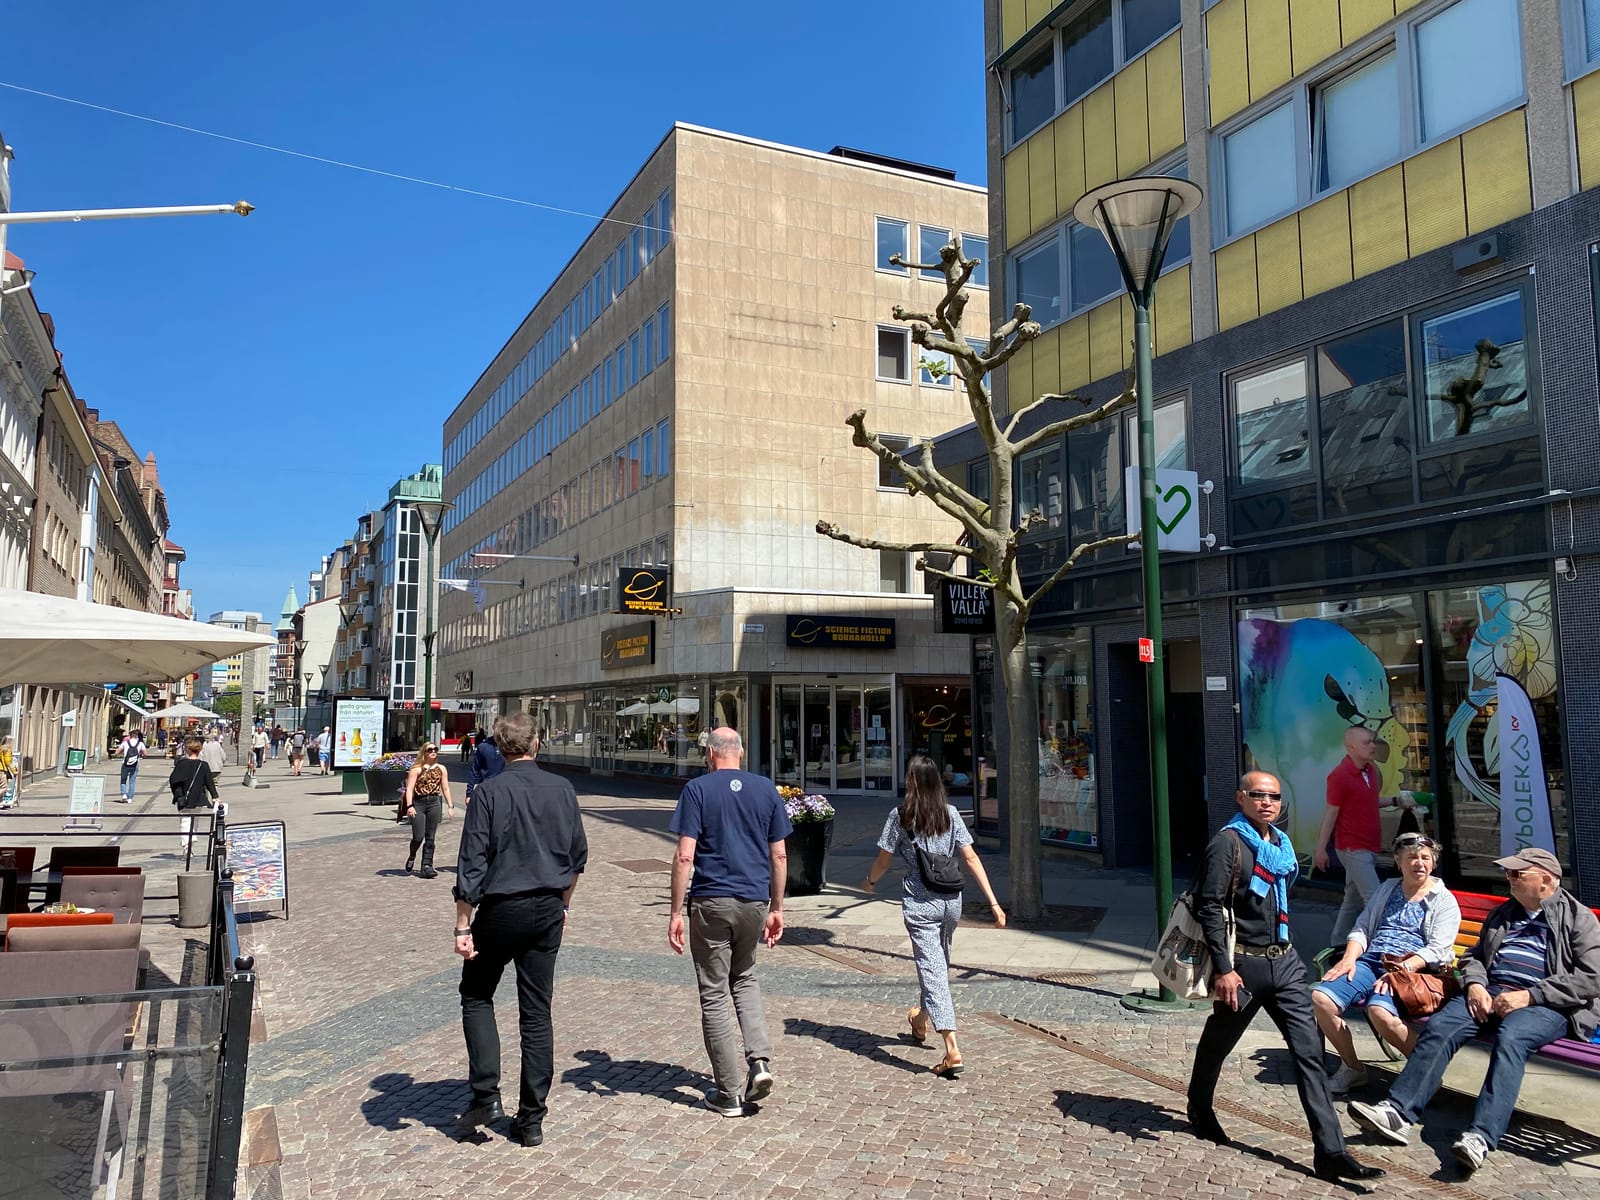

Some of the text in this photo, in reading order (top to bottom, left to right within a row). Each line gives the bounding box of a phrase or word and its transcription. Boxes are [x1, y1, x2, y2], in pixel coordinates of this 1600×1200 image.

[949, 584, 987, 600] VILLER
[951, 600, 985, 615] VALLA
[825, 625, 892, 635] SCIENCE FICTION
